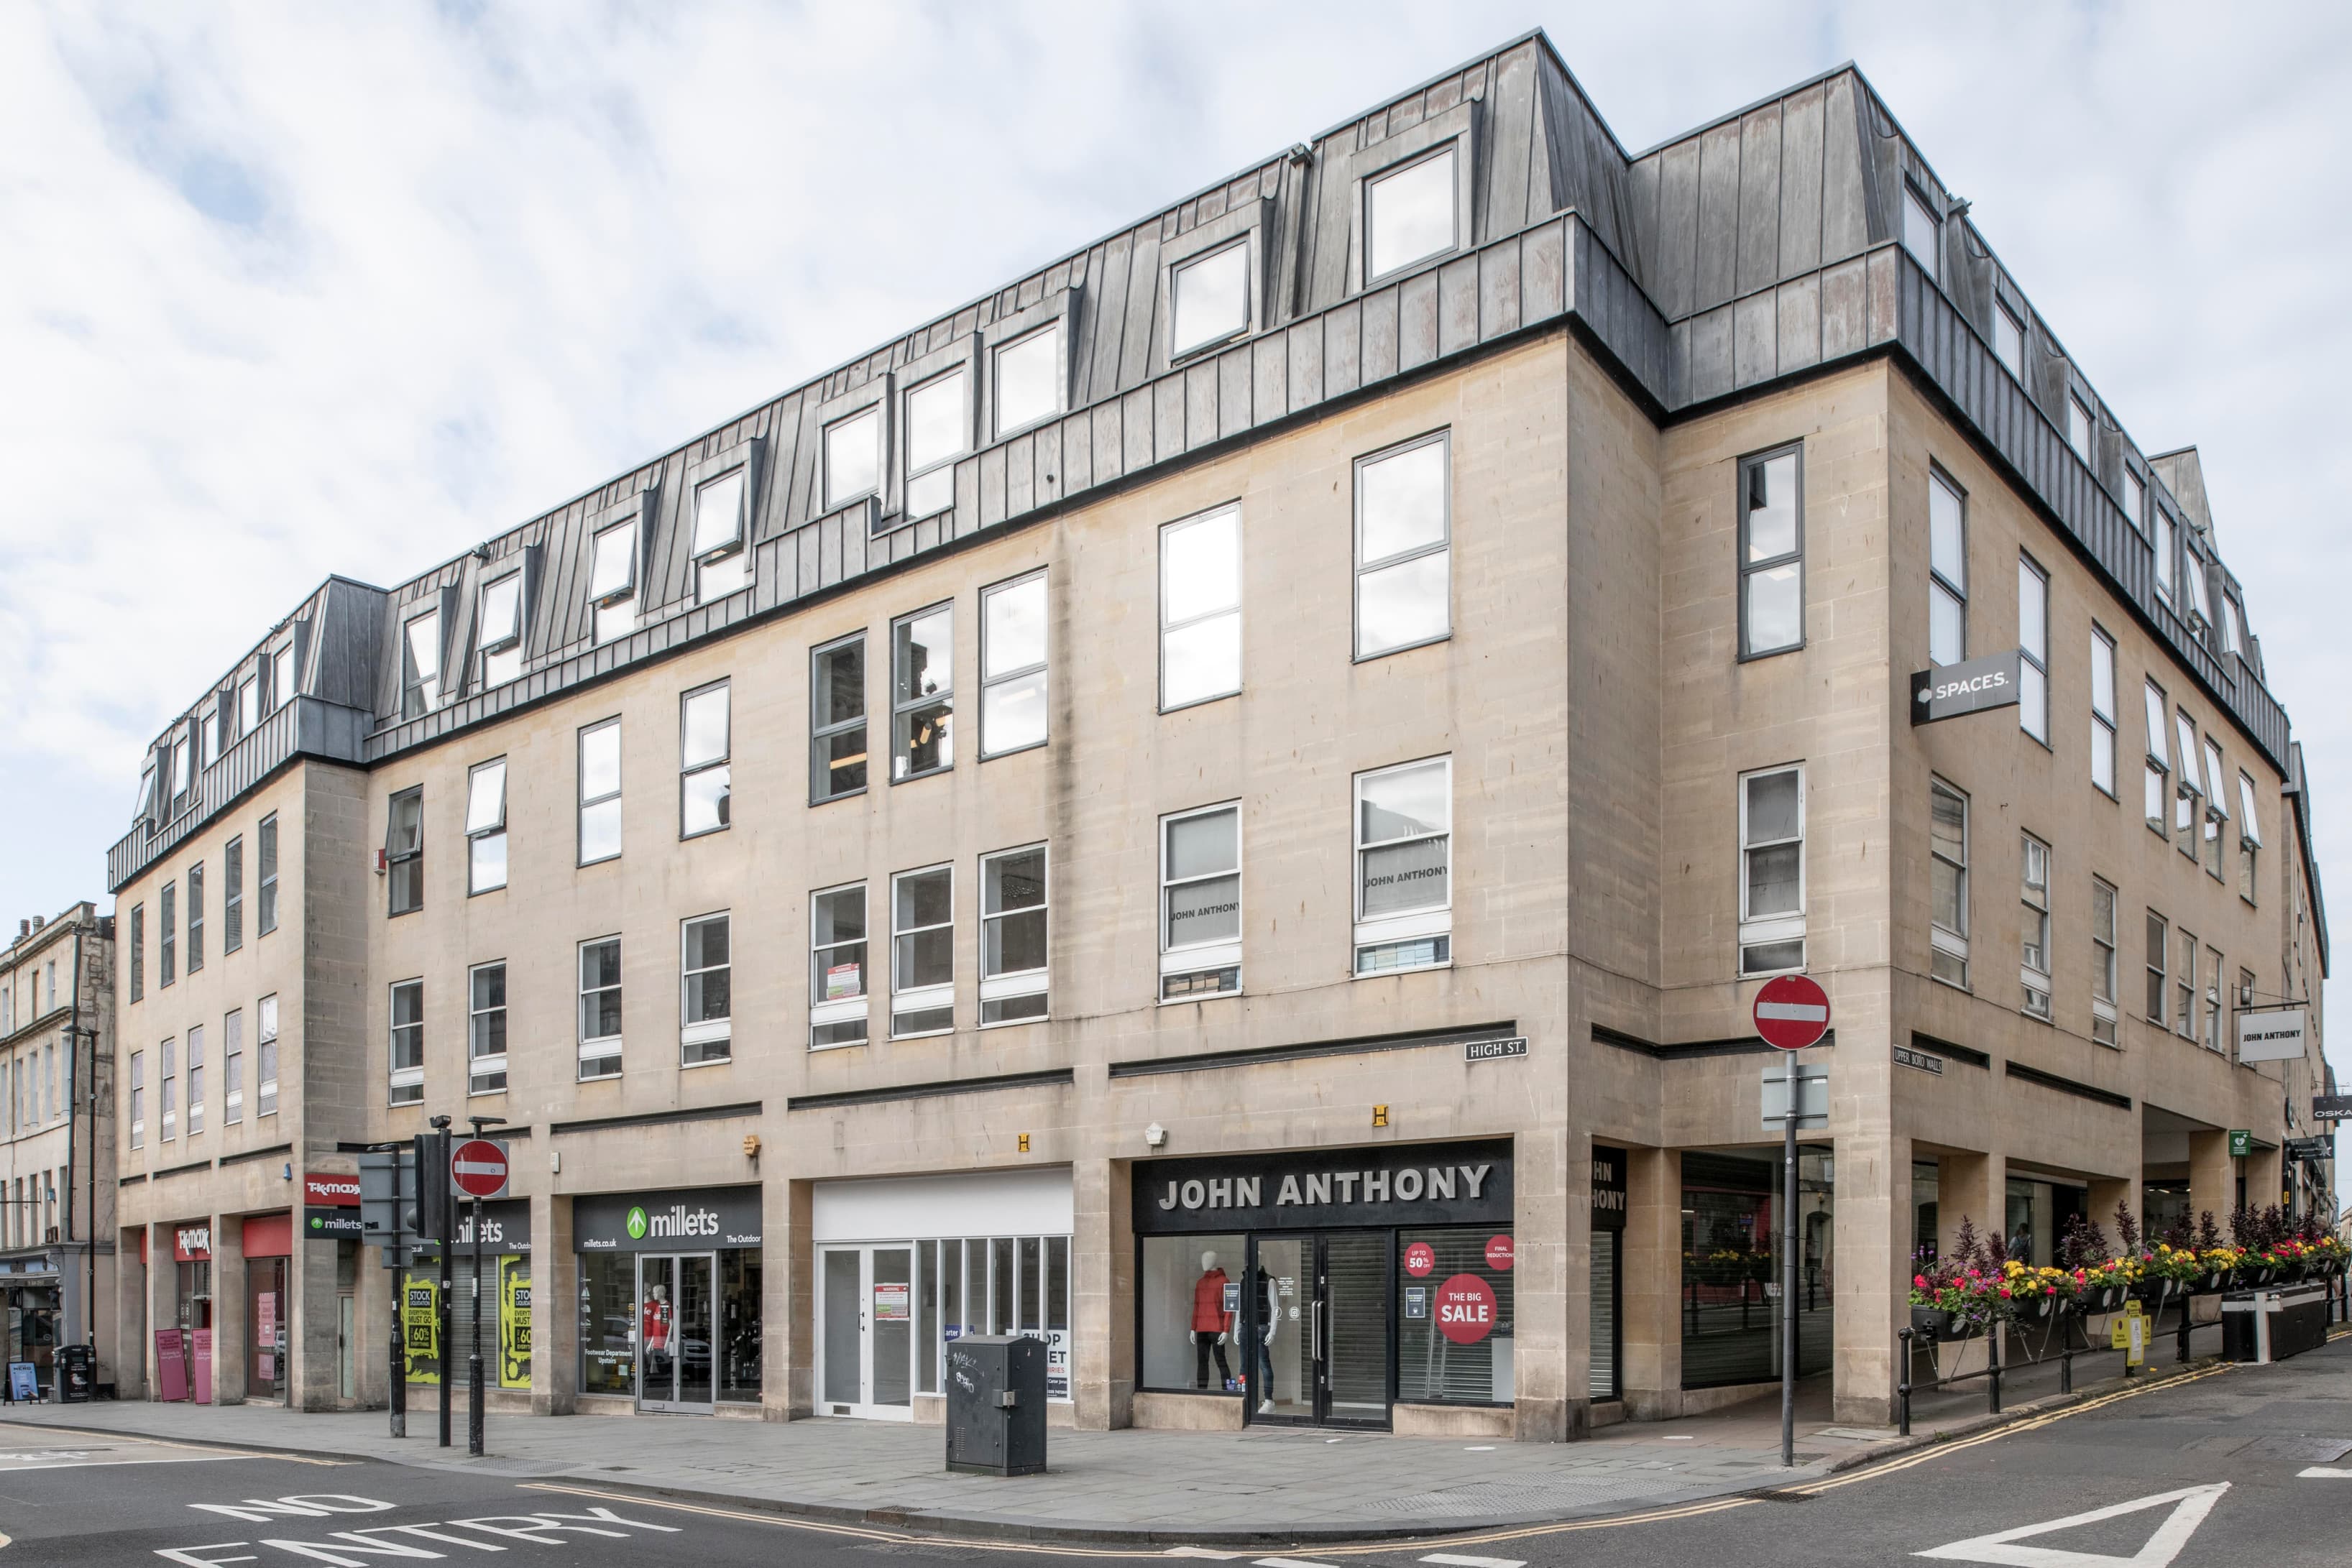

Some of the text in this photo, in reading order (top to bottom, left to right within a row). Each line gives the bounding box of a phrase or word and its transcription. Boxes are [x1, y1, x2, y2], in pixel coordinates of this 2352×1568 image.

[1936, 672, 2009, 699] SPACES.
[1364, 875, 1394, 887] JOHN
[1170, 909, 1195, 921] JOHN
[2243, 1030, 2300, 1042] JOHN ANTHONY
[1471, 1041, 1524, 1057] HIGH ST.
[1895, 1048, 1909, 1063] UPPER
[1926, 1058, 1942, 1071] WALLS
[1594, 1161, 1612, 1182] HN
[1158, 1164, 1491, 1210] JOHN ANTHONY
[325, 1218, 362, 1230] millets
[651, 1205, 719, 1237] millets
[584, 1239, 617, 1248] millets.co.uk
[727, 1234, 761, 1244] The Outdoor
[410, 1291, 431, 1301] STOCK
[1449, 1293, 1482, 1301] THE BIG
[1441, 1305, 1489, 1322] SALE
[606, 1350, 633, 1358] Department
[1049, 1351, 1066, 1364] ET
[185, 1494, 400, 1522] NO
